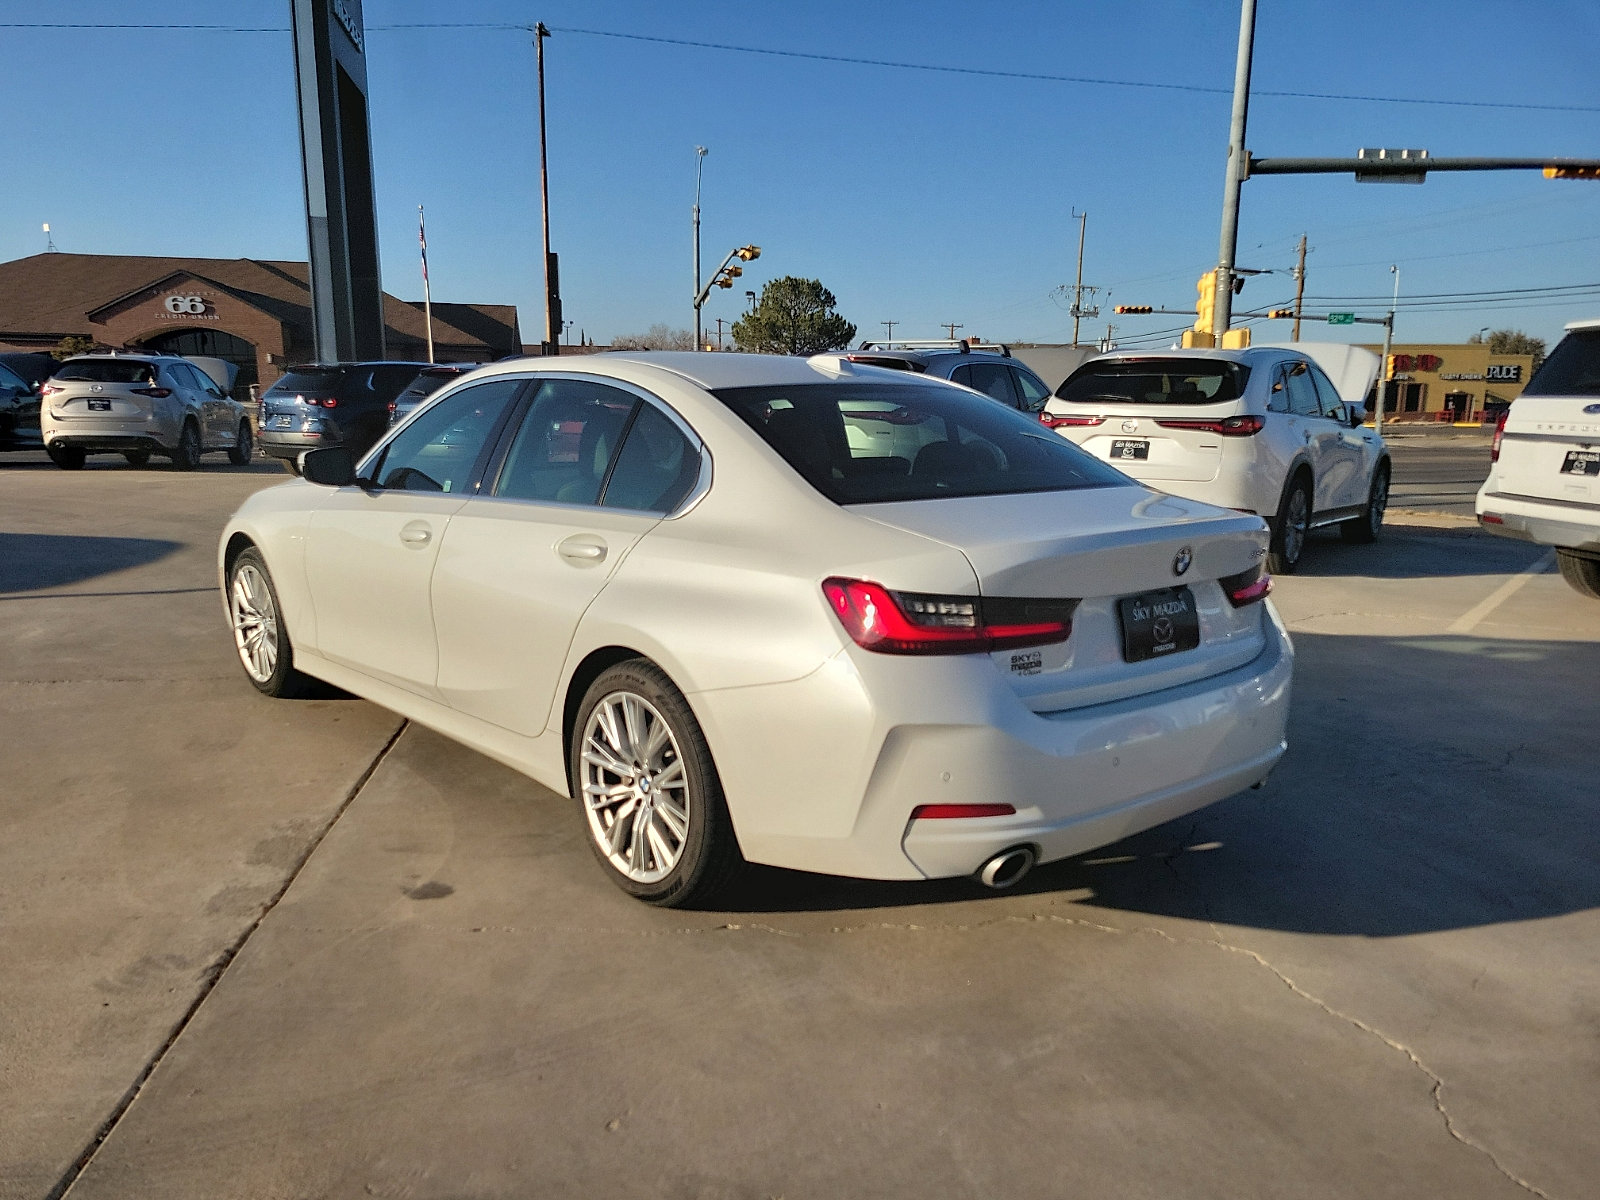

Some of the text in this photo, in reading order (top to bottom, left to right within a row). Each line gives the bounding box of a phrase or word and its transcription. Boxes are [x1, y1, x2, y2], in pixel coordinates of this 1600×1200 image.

[165, 296, 206, 314] 66
[1132, 601, 1188, 620] SKY MAZDA
[1011, 653, 1031, 663] SKY
